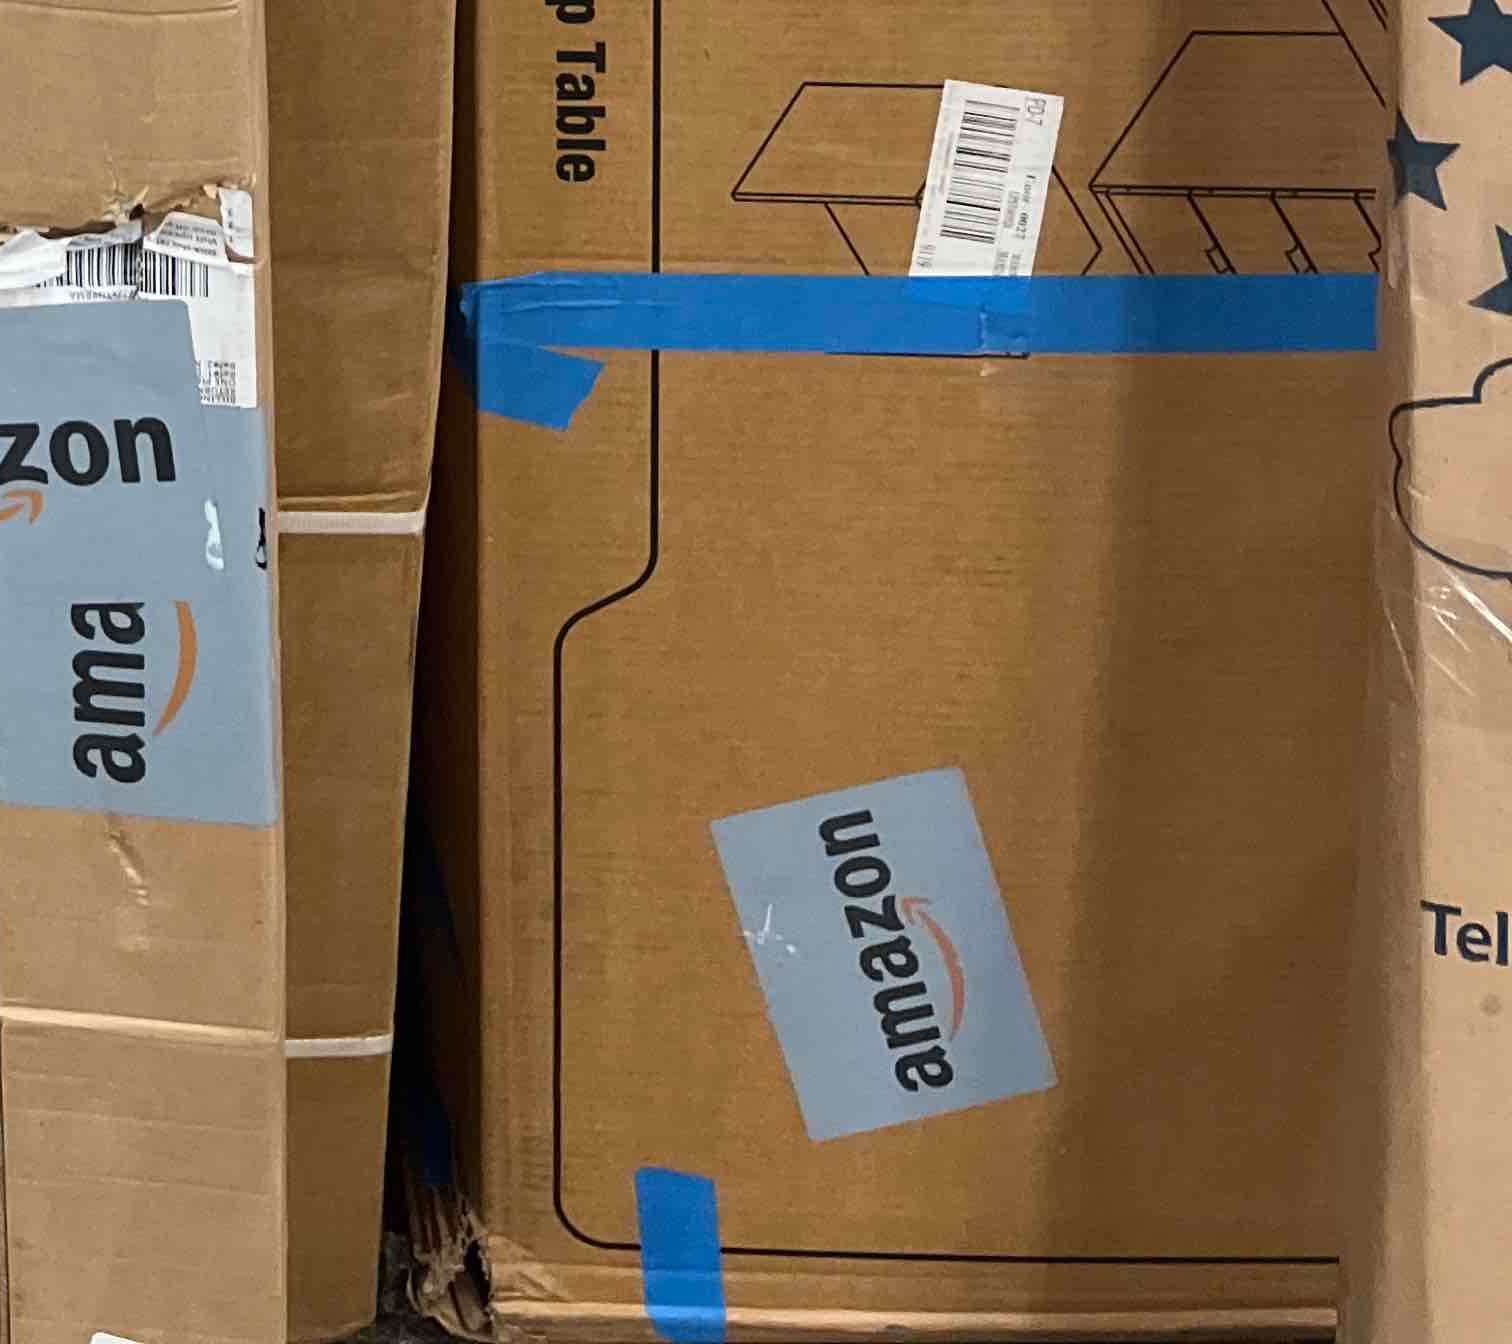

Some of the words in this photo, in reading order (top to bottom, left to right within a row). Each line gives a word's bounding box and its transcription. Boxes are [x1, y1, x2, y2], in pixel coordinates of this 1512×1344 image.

[555, 41, 607, 184] Table
[70, 600, 146, 784] ama
[816, 807, 956, 1093] amazon
